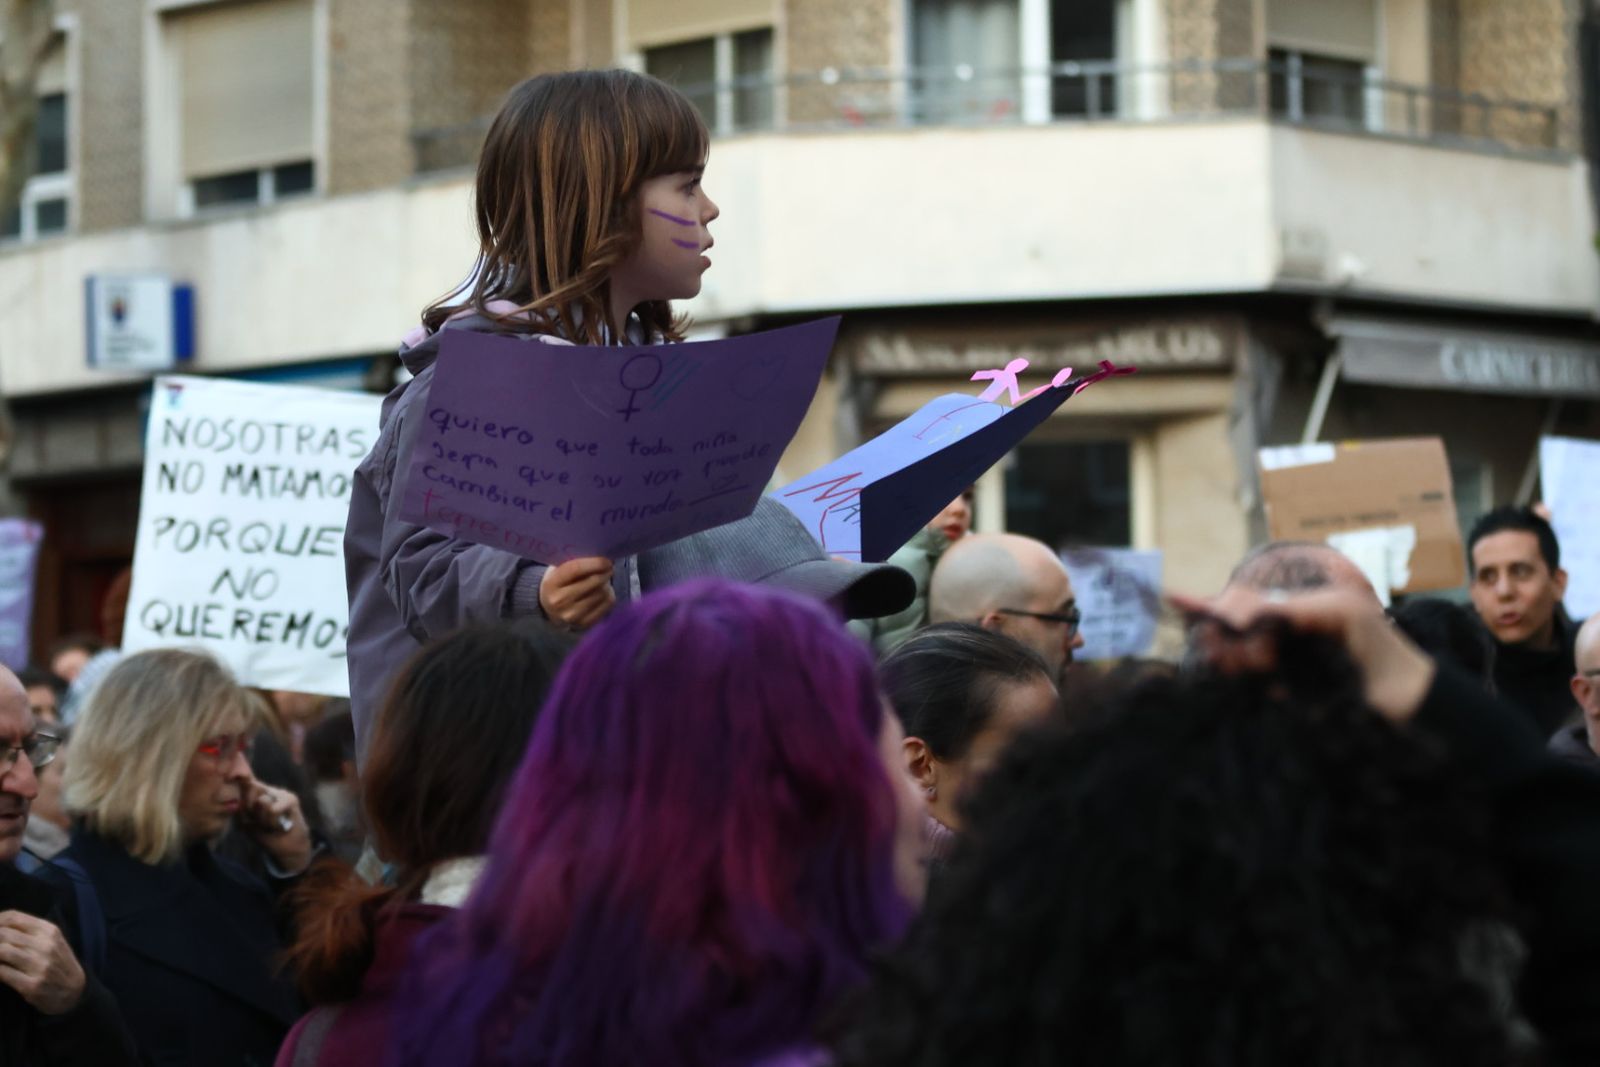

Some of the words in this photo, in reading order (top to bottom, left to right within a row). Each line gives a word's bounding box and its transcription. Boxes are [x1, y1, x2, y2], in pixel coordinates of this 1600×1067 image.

[162, 417, 368, 458] NOSOTRAS
[428, 407, 534, 446] quiero
[555, 438, 600, 457] que
[625, 436, 675, 457] toda
[691, 431, 738, 455] niña
[158, 461, 205, 494] NO
[220, 463, 350, 503] MATAMO
[518, 465, 571, 487] que
[592, 475, 622, 491] su
[642, 469, 684, 487] voz
[701, 442, 773, 478] puede
[550, 499, 574, 522] el
[599, 489, 684, 526] mundo
[153, 517, 344, 557] PORQUE
[210, 567, 279, 601] NO
